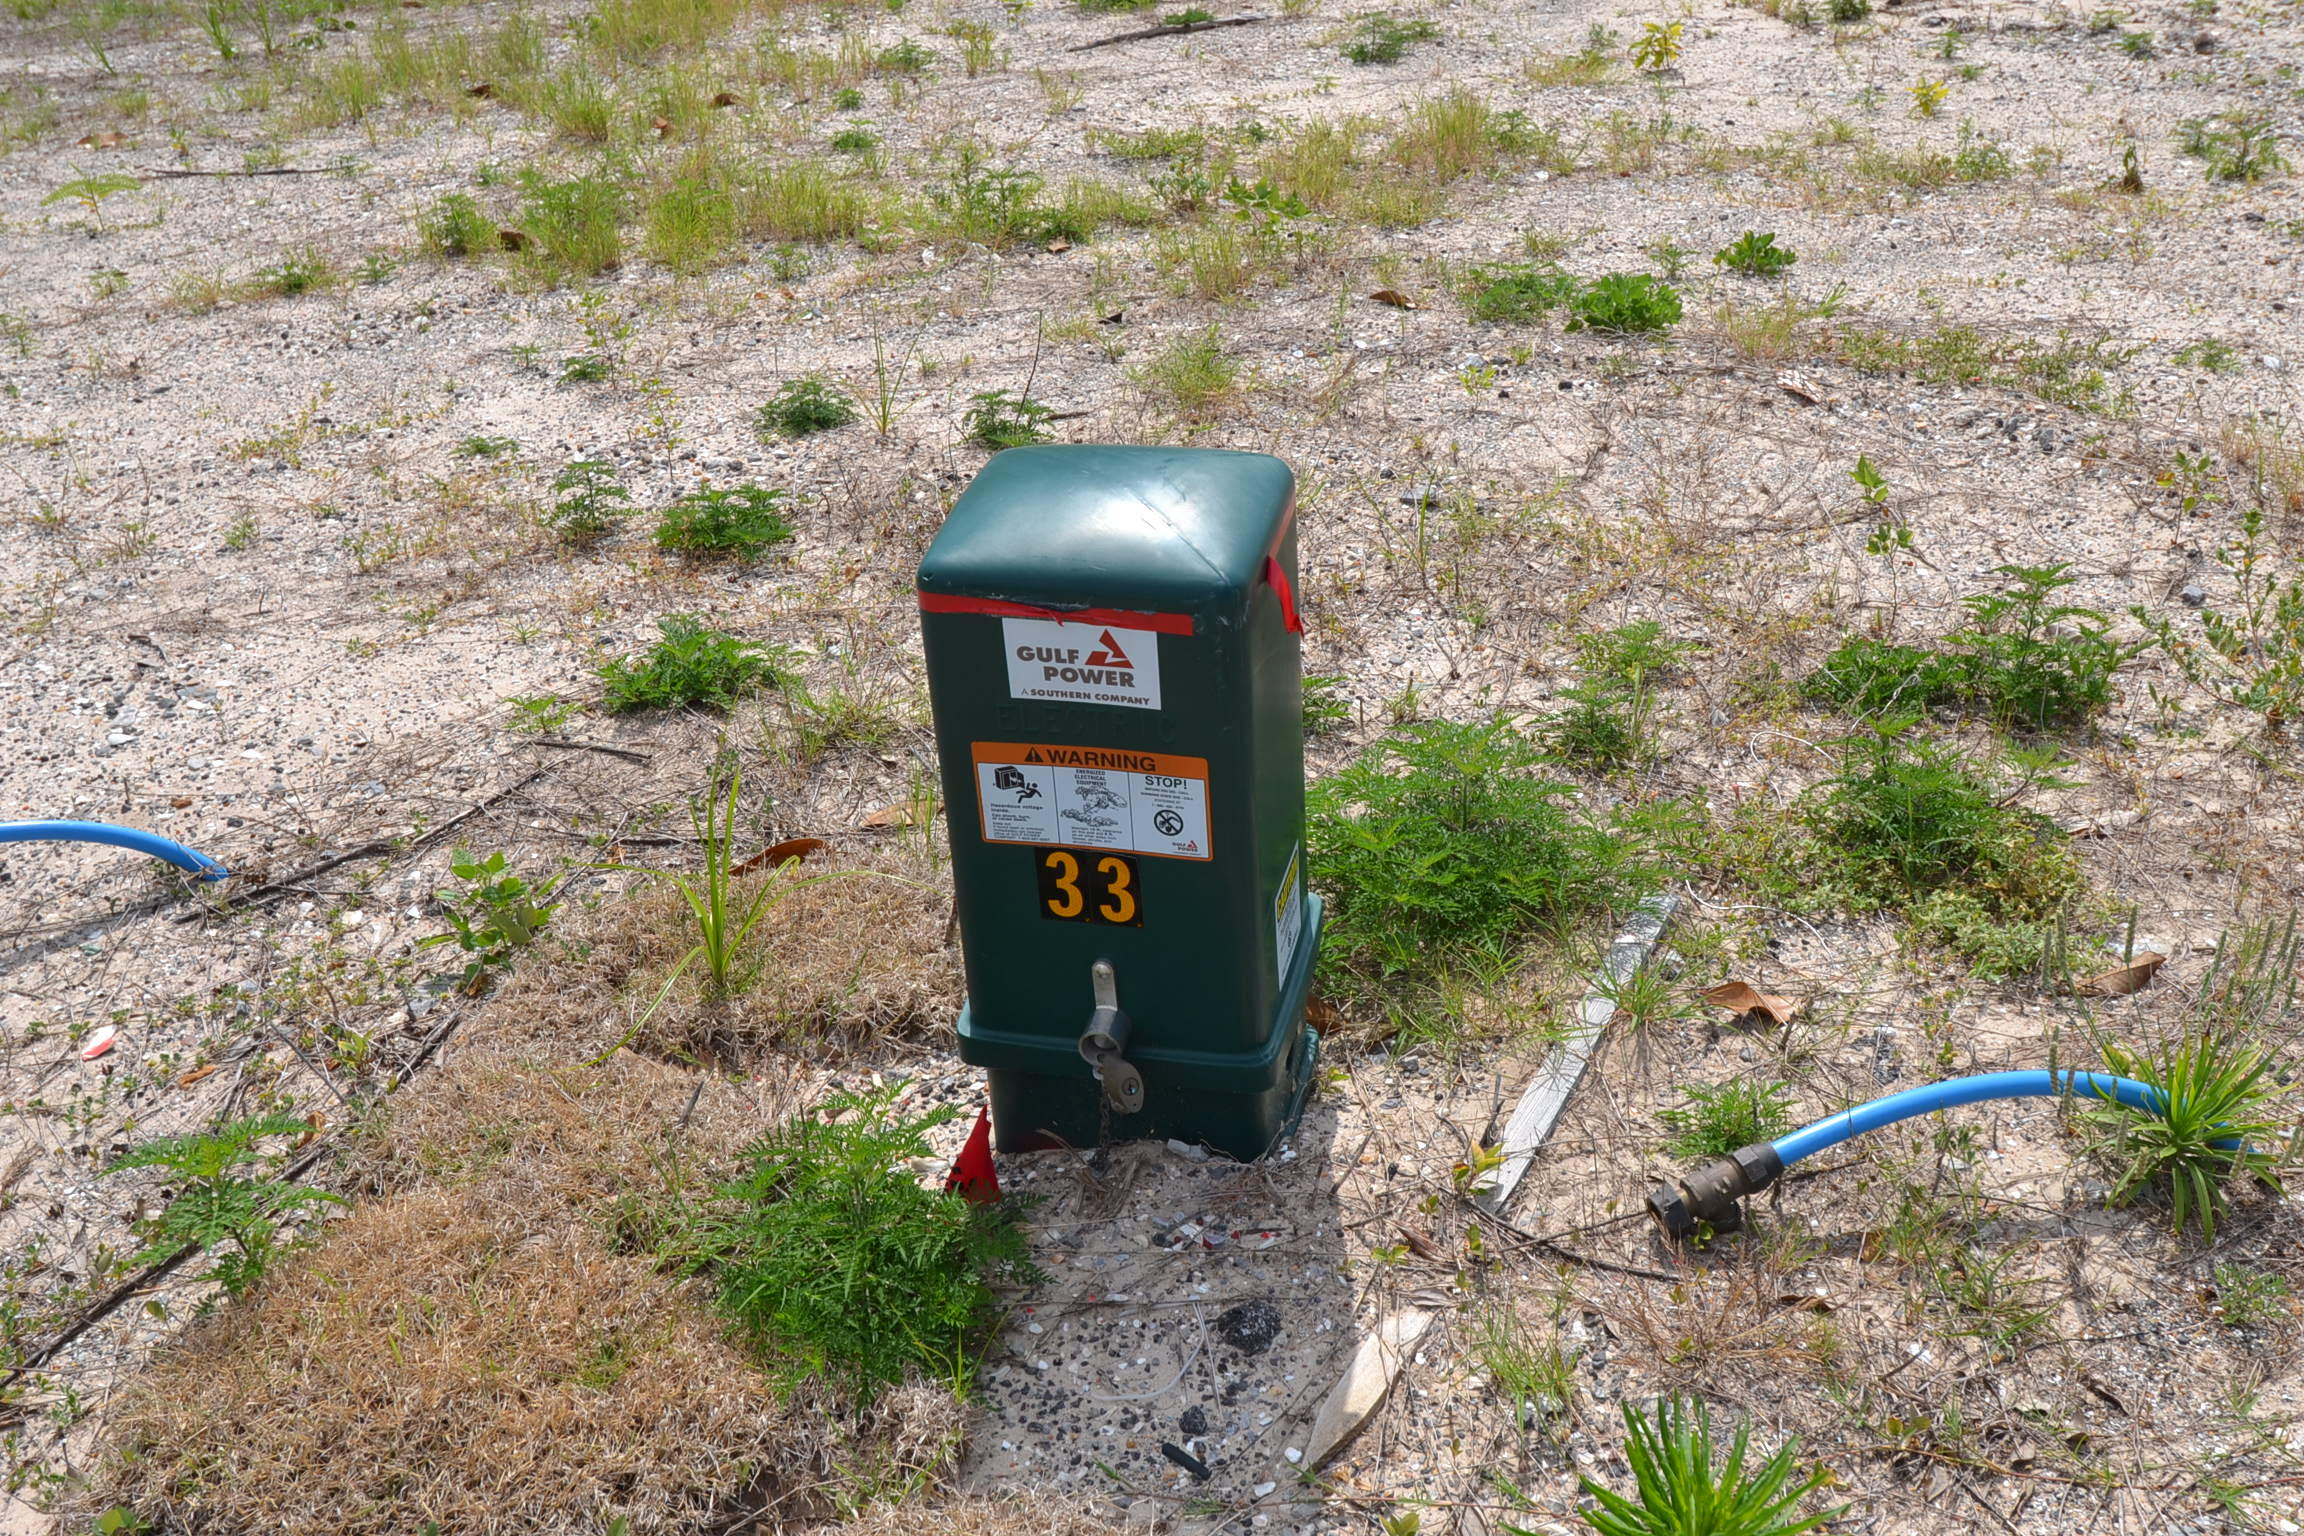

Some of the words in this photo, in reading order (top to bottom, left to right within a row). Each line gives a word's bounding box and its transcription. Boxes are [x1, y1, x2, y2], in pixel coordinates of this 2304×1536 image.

[1016, 646, 1080, 665] GULF
[1043, 666, 1135, 688] POWER
[1021, 688, 1029, 696] A
[1031, 688, 1091, 701] SOUTHERN
[1095, 692, 1150, 706] COMPANY
[1046, 748, 1156, 772] WARNING
[1075, 768, 1106, 776] ENERGIZED
[1144, 775, 1187, 790] STOP!
